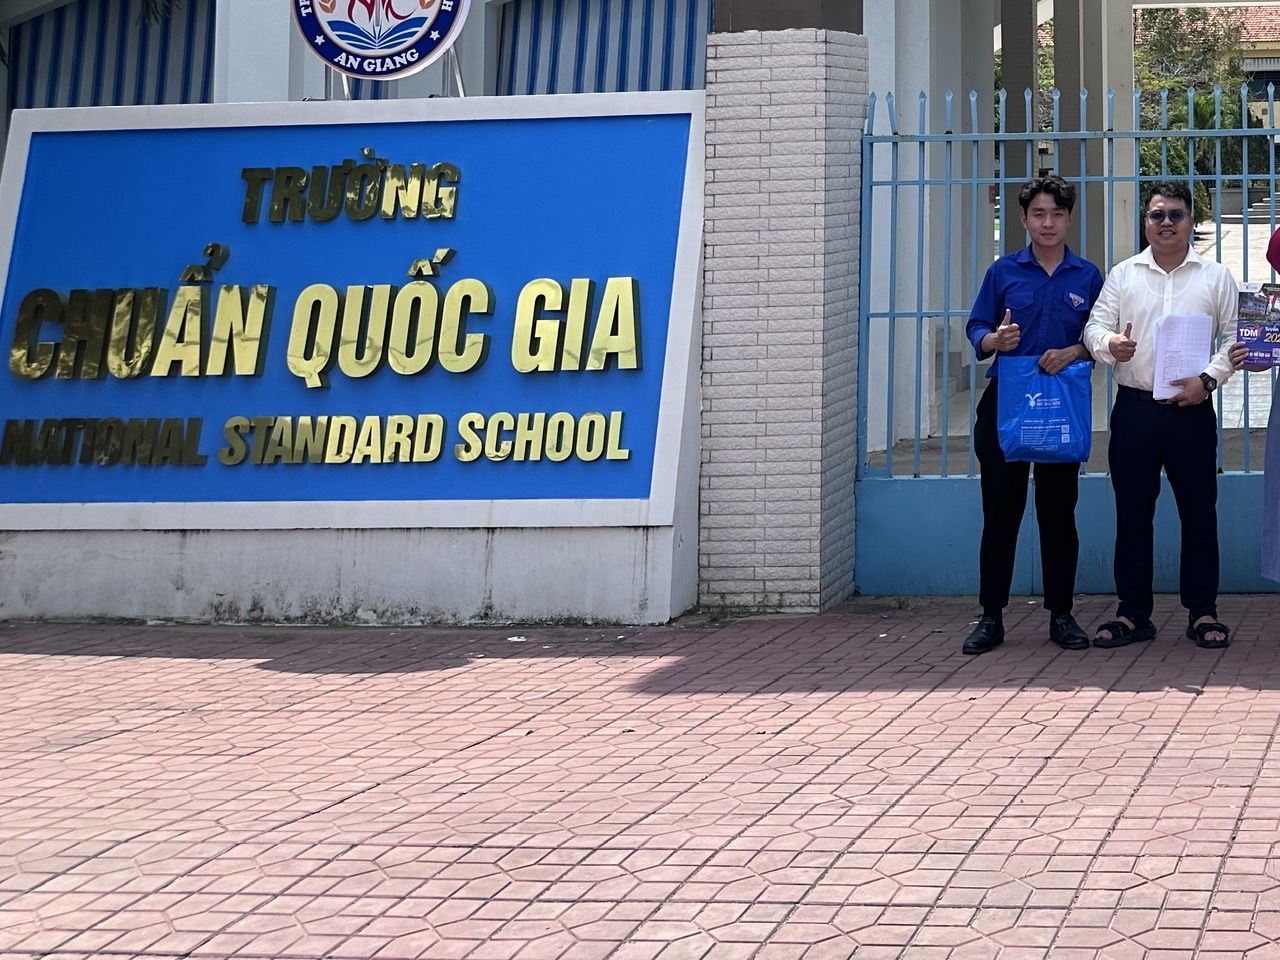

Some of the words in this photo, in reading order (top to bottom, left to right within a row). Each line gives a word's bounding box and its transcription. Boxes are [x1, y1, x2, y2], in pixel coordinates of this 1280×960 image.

[334, 52, 362, 70] AN
[363, 48, 420, 72] GIANG
[240, 146, 461, 224] TRƯỜNG
[8, 243, 276, 381] CHUẨN
[286, 247, 496, 389] QUỐC
[510, 276, 642, 374] GIA
[1240, 329, 1258, 337] TDM
[0, 416, 208, 467] NATIONAL
[218, 412, 446, 466] STANDARD
[455, 410, 631, 462] SCHOOL
